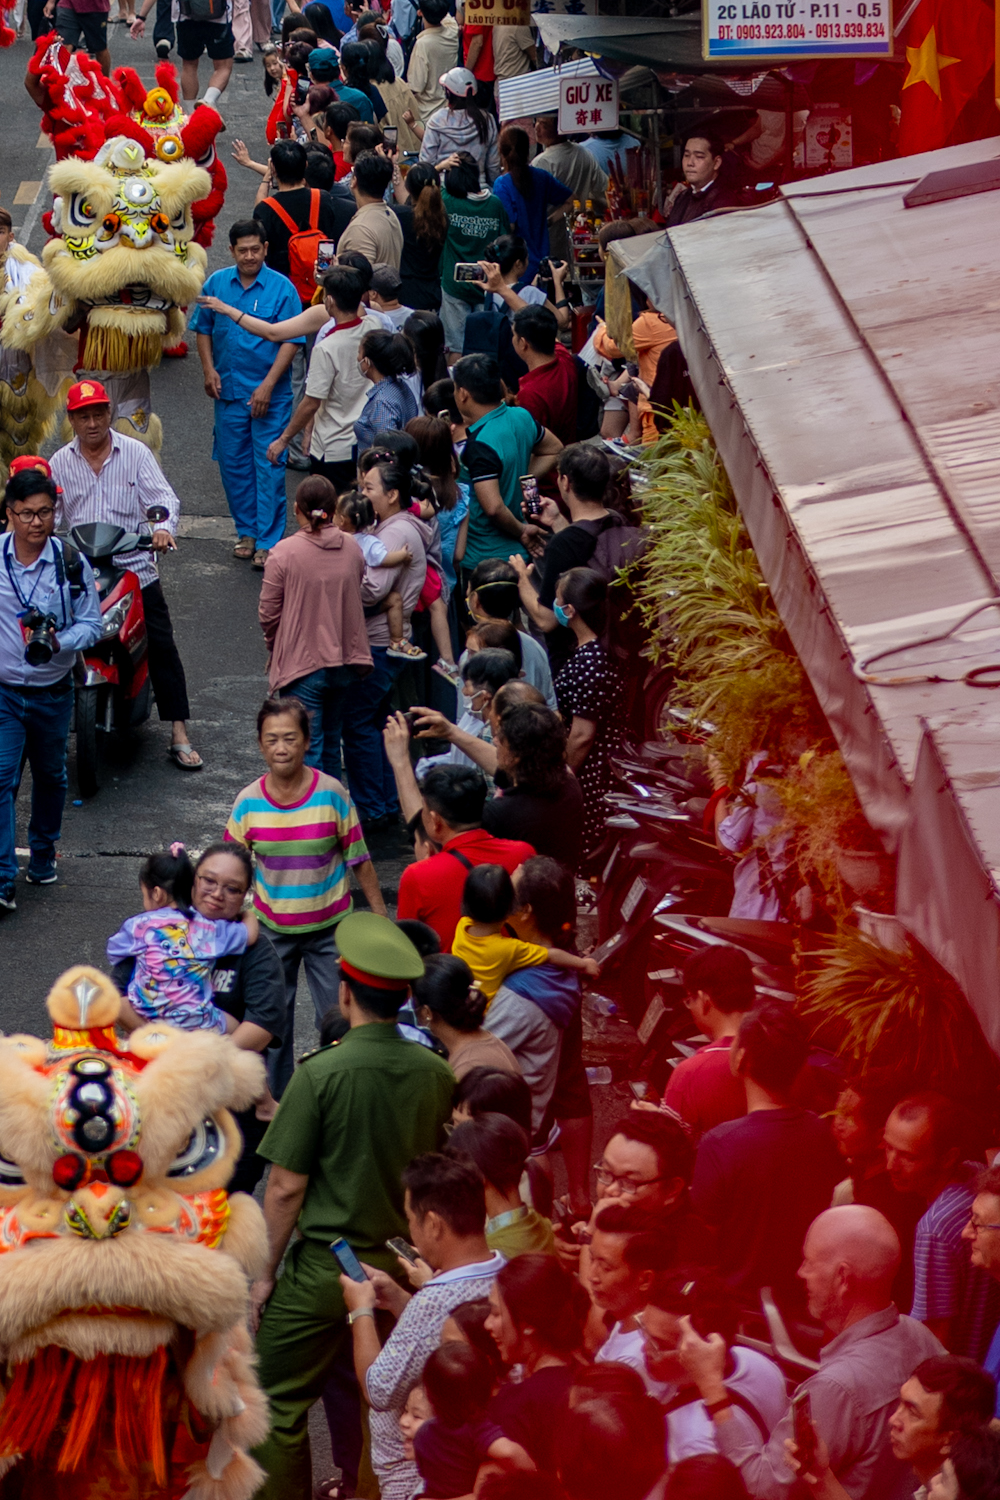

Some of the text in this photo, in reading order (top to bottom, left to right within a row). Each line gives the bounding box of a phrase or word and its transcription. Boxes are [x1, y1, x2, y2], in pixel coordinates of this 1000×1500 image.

[718, 5, 737, 19] 2C
[742, 1, 771, 19] LÃO
[810, 3, 840, 18] P.11
[858, 2, 882, 18] Q.5
[718, 25, 734, 40] ĐT:
[737, 23, 806, 40] 0903.923.804
[816, 22, 885, 39] 0913.939.834
[566, 82, 613, 104] GIỮ XE
